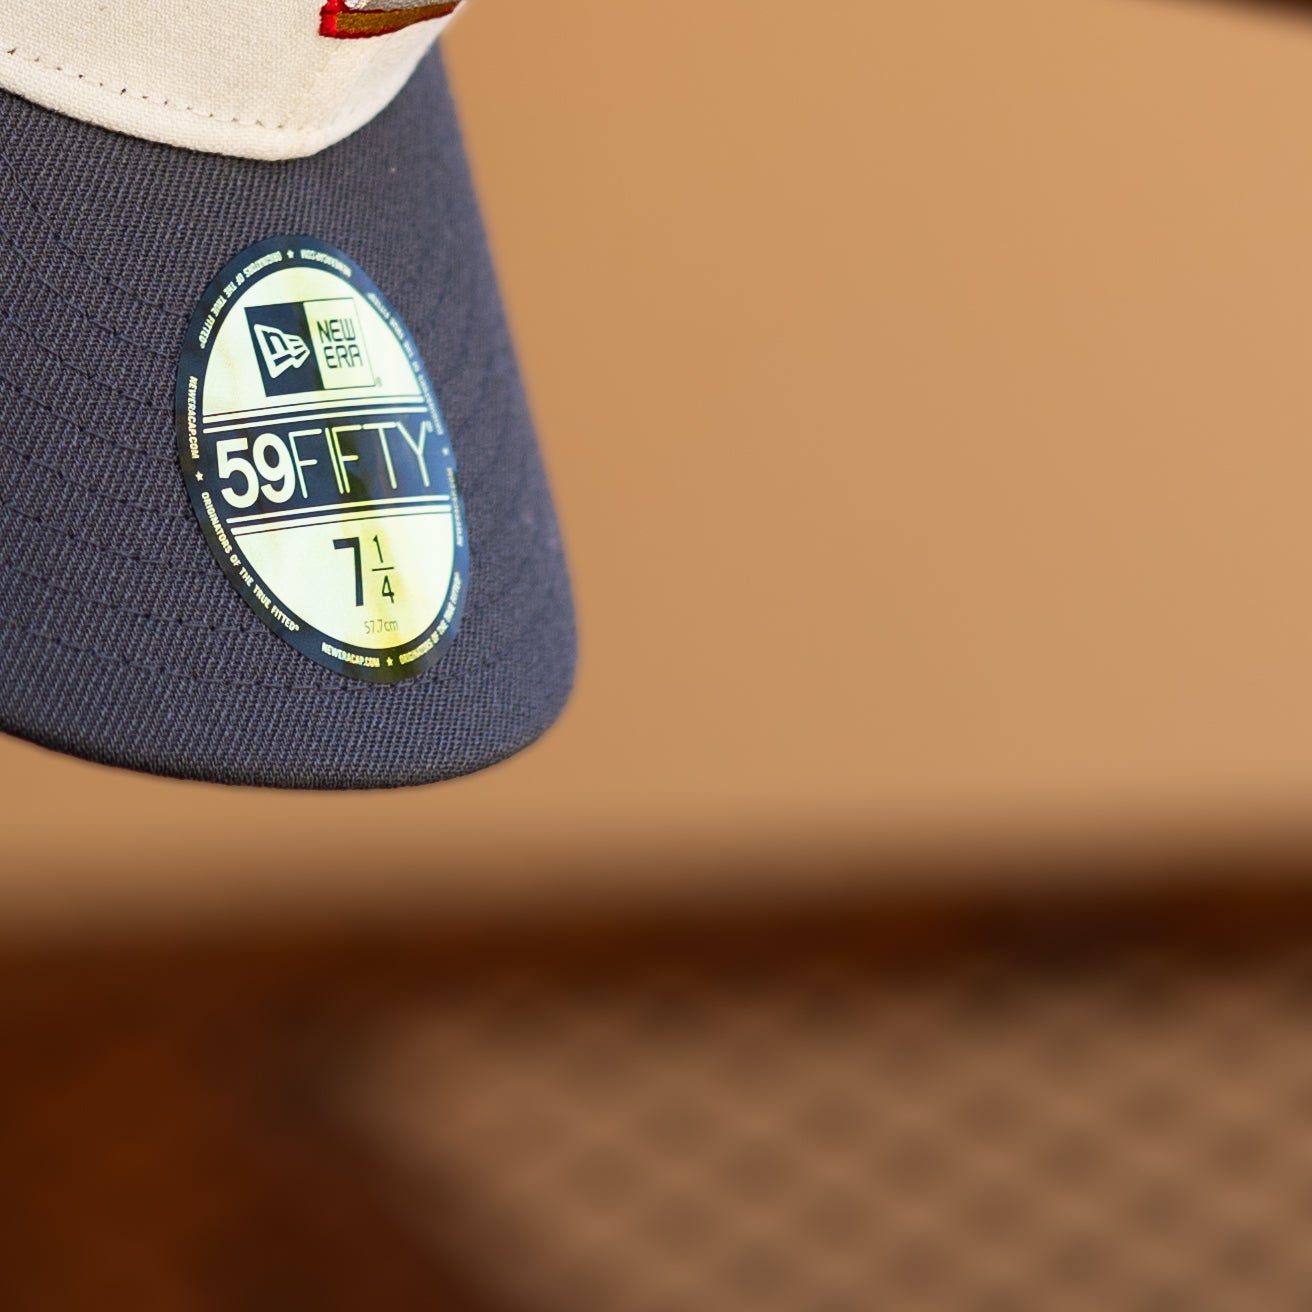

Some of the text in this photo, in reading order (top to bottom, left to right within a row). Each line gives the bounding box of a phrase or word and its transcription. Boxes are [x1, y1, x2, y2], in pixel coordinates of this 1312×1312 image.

[316, 318, 357, 344] NEW
[324, 344, 364, 369] ERA
[188, 376, 200, 459] NEWERACAP.COM
[202, 491, 233, 554] ORIGINATORS
[229, 554, 242, 567] OF
[238, 567, 255, 587] THE
[252, 583, 272, 609] TRUE
[364, 618, 399, 635] 57.7cm
[321, 642, 381, 668] NEWERACAP.COM
